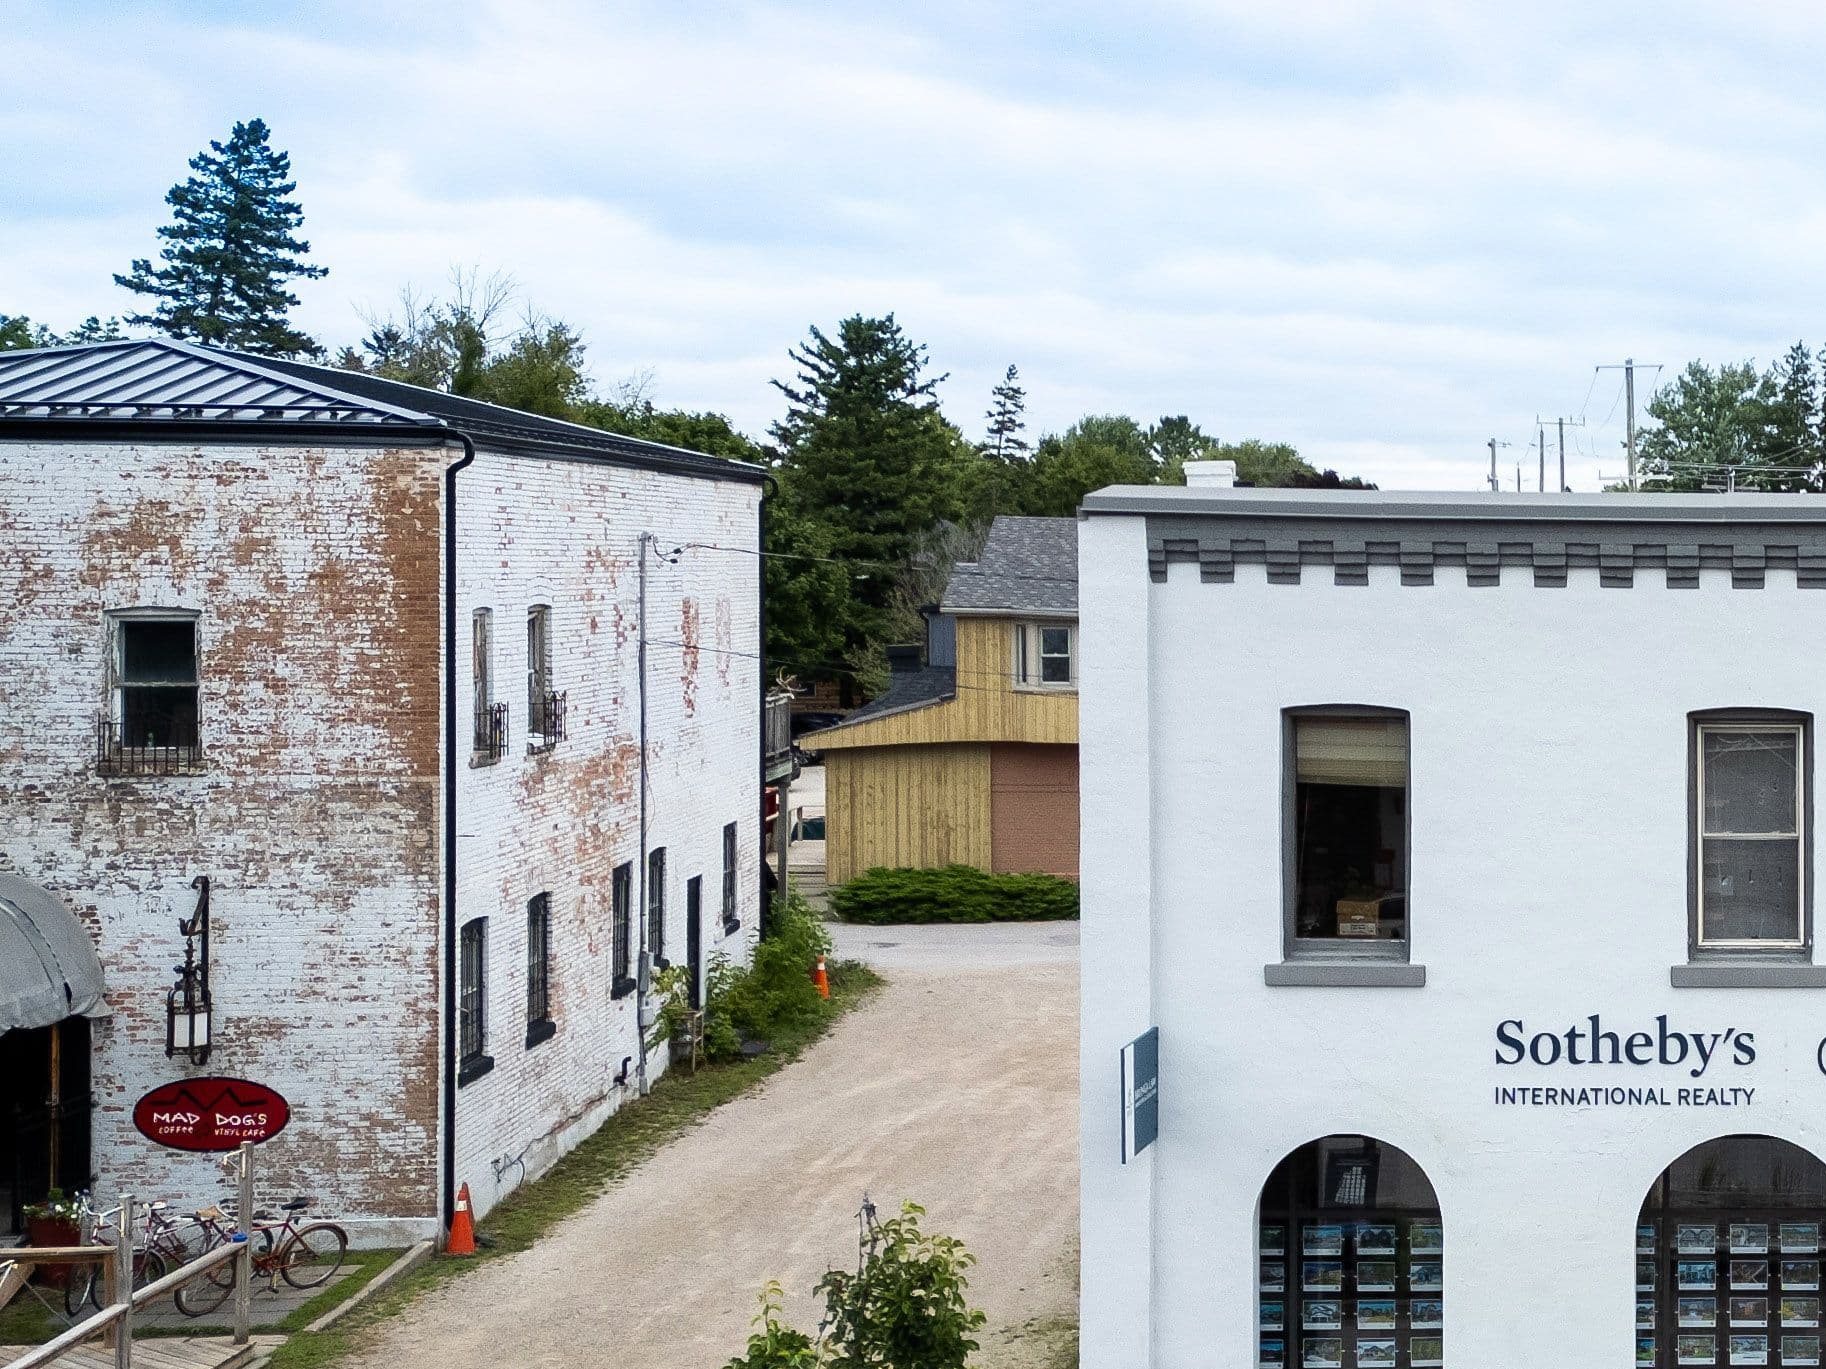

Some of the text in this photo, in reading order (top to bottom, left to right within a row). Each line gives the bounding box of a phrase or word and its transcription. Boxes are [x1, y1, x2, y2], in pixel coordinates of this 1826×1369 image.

[1494, 1014, 1757, 1077] Sotheby's
[1494, 1086, 1756, 1106] INTERNATIONAL REALTY
[153, 1112, 268, 1126] MAD DOG'S
